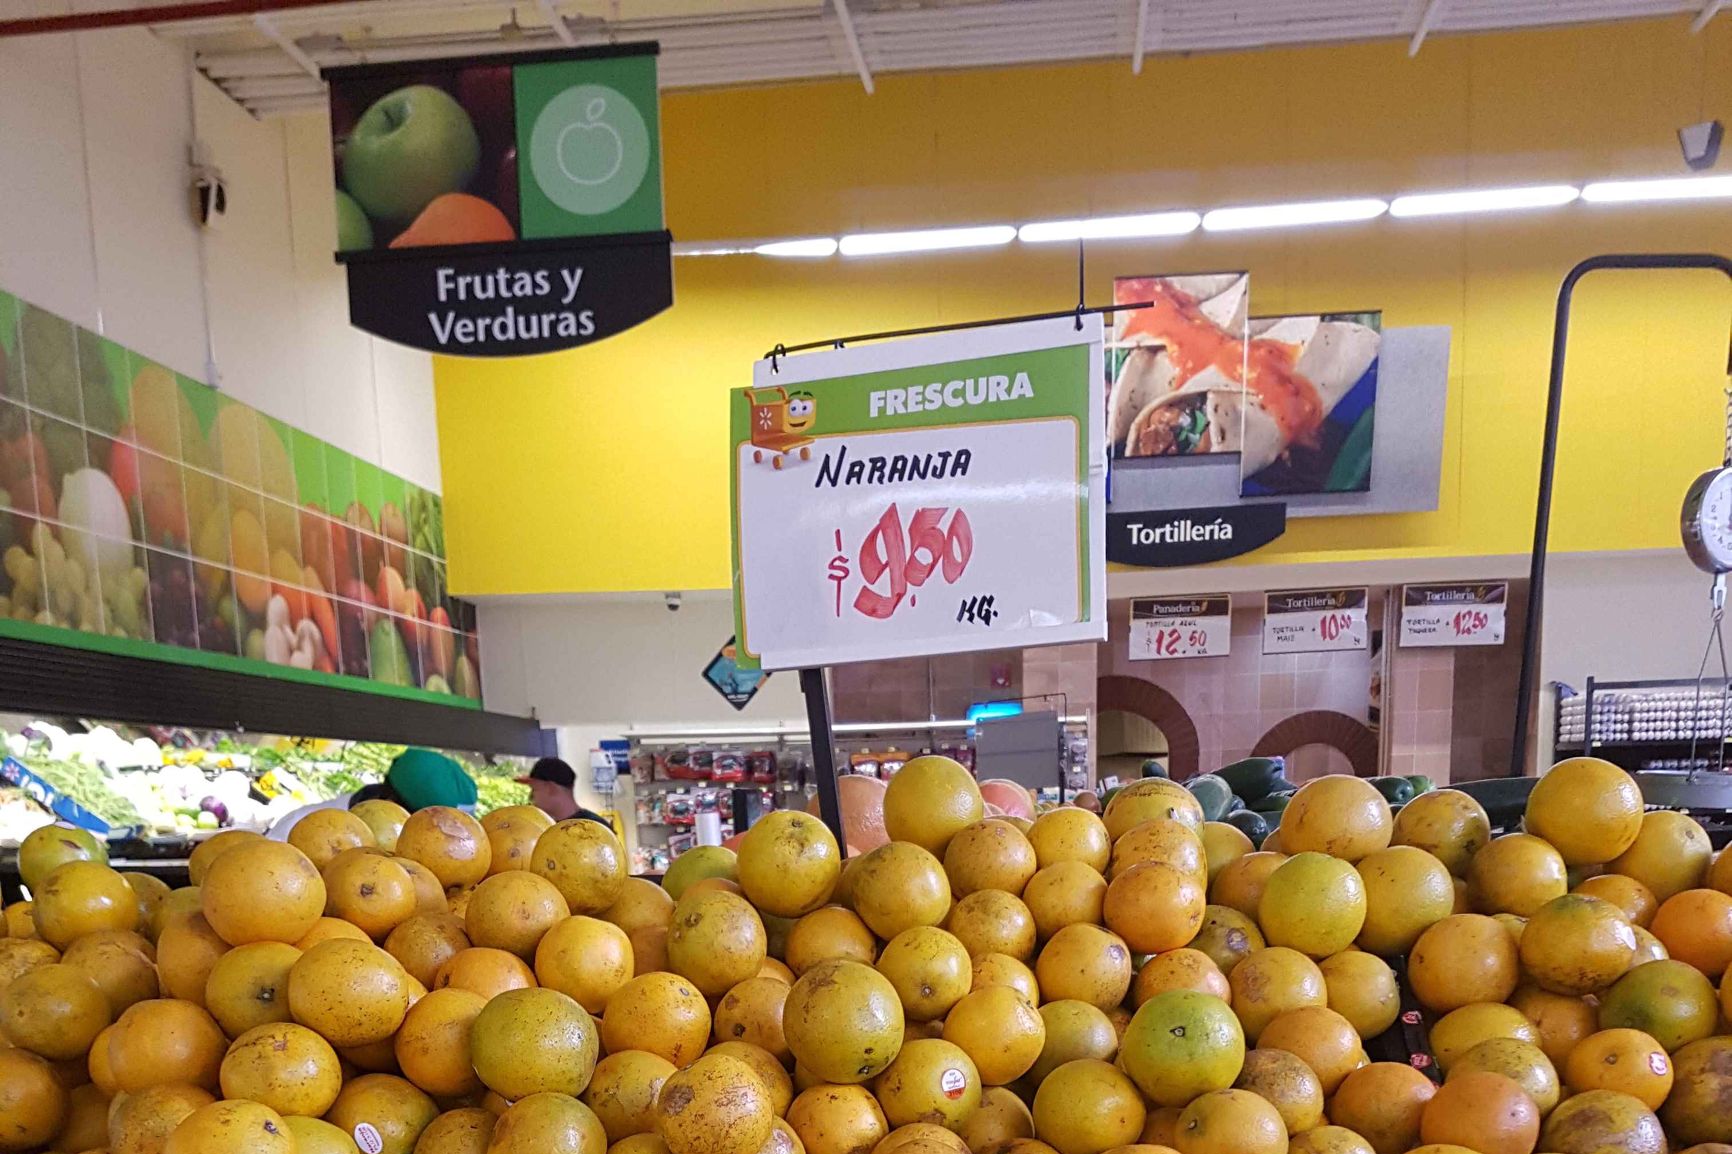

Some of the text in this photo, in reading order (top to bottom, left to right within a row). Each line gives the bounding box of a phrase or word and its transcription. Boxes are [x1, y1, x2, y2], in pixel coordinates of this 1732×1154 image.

[436, 267, 583, 304] Frutas y
[428, 306, 596, 344] Verduras
[869, 372, 1034, 418] FRESCURA
[815, 445, 972, 488] NARANJA
[1127, 518, 1233, 545] Tortillería
